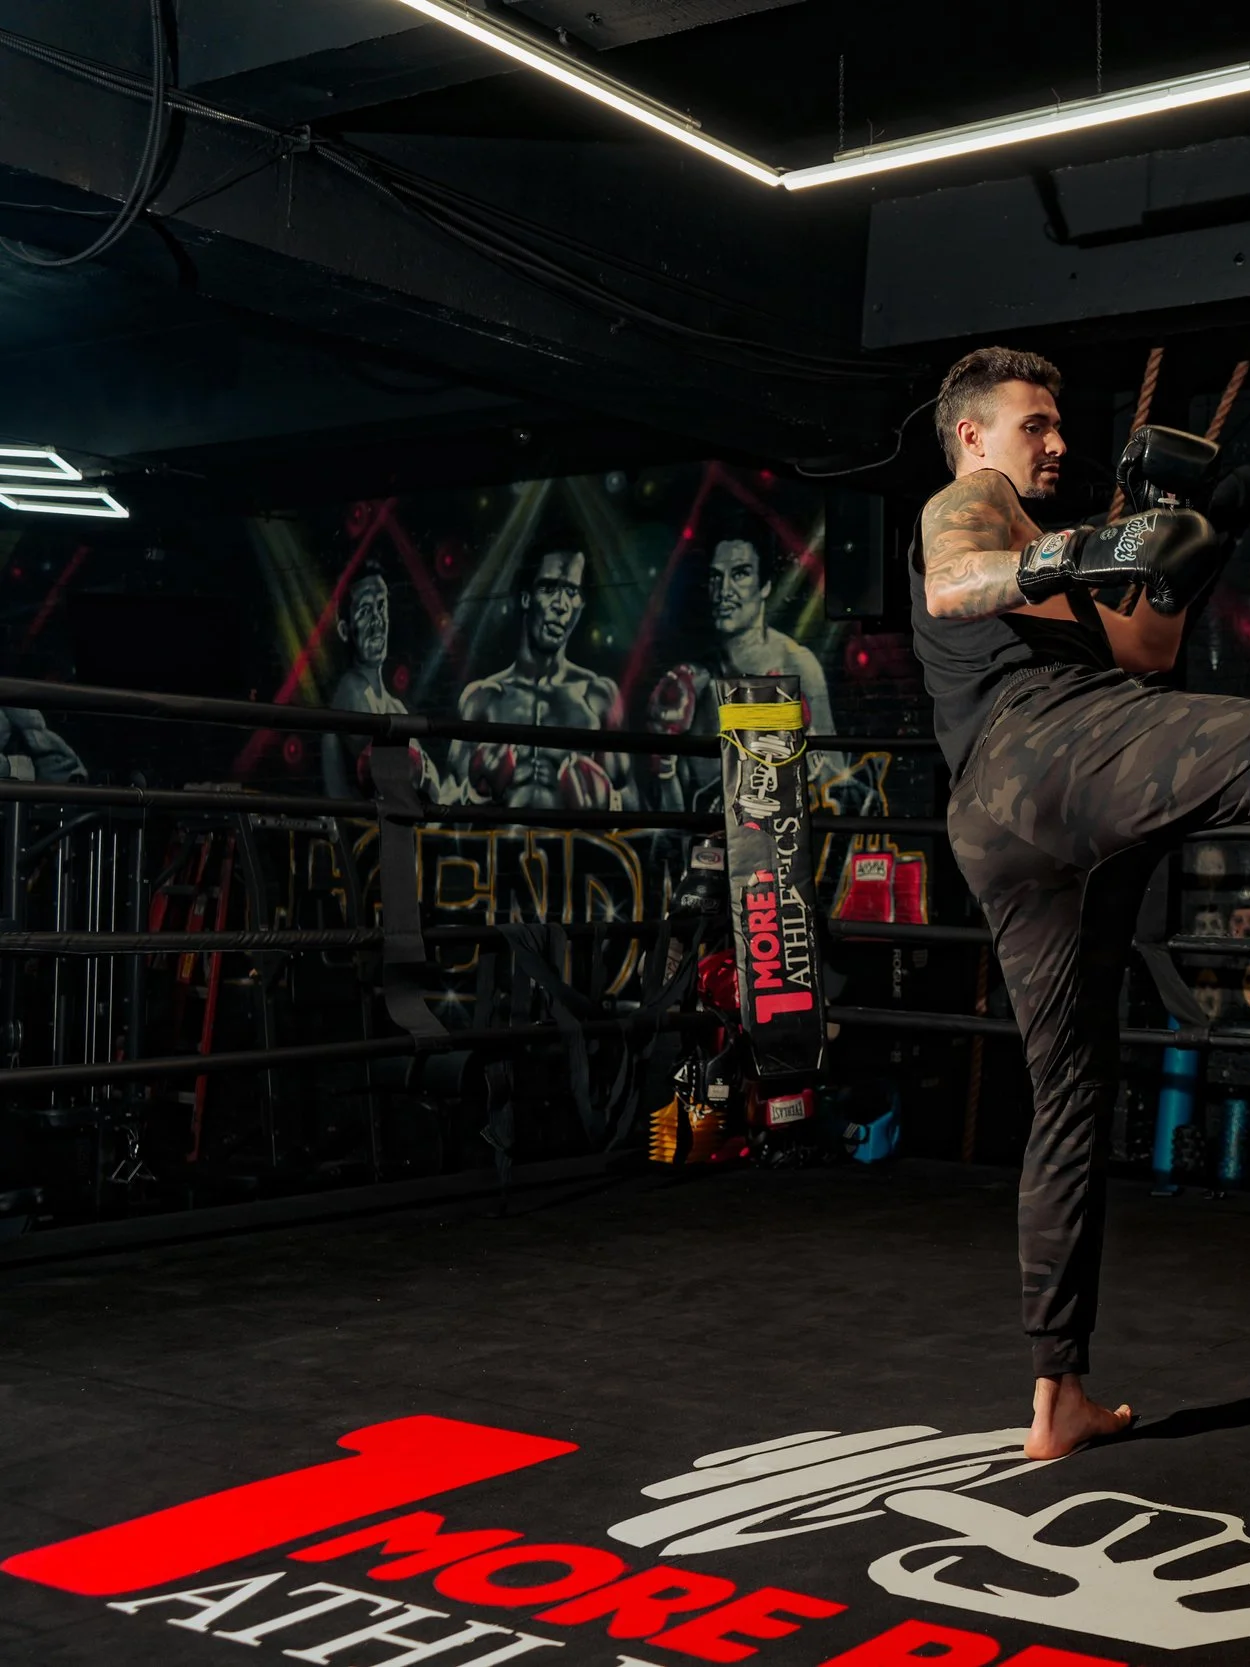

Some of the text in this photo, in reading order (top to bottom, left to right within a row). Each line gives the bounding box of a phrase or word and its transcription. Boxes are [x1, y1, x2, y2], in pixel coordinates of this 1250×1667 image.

[746, 890, 784, 990] MORE
[755, 991, 814, 1024] 1
[0, 1414, 580, 1596] 1
[286, 1510, 848, 1664] MORE
